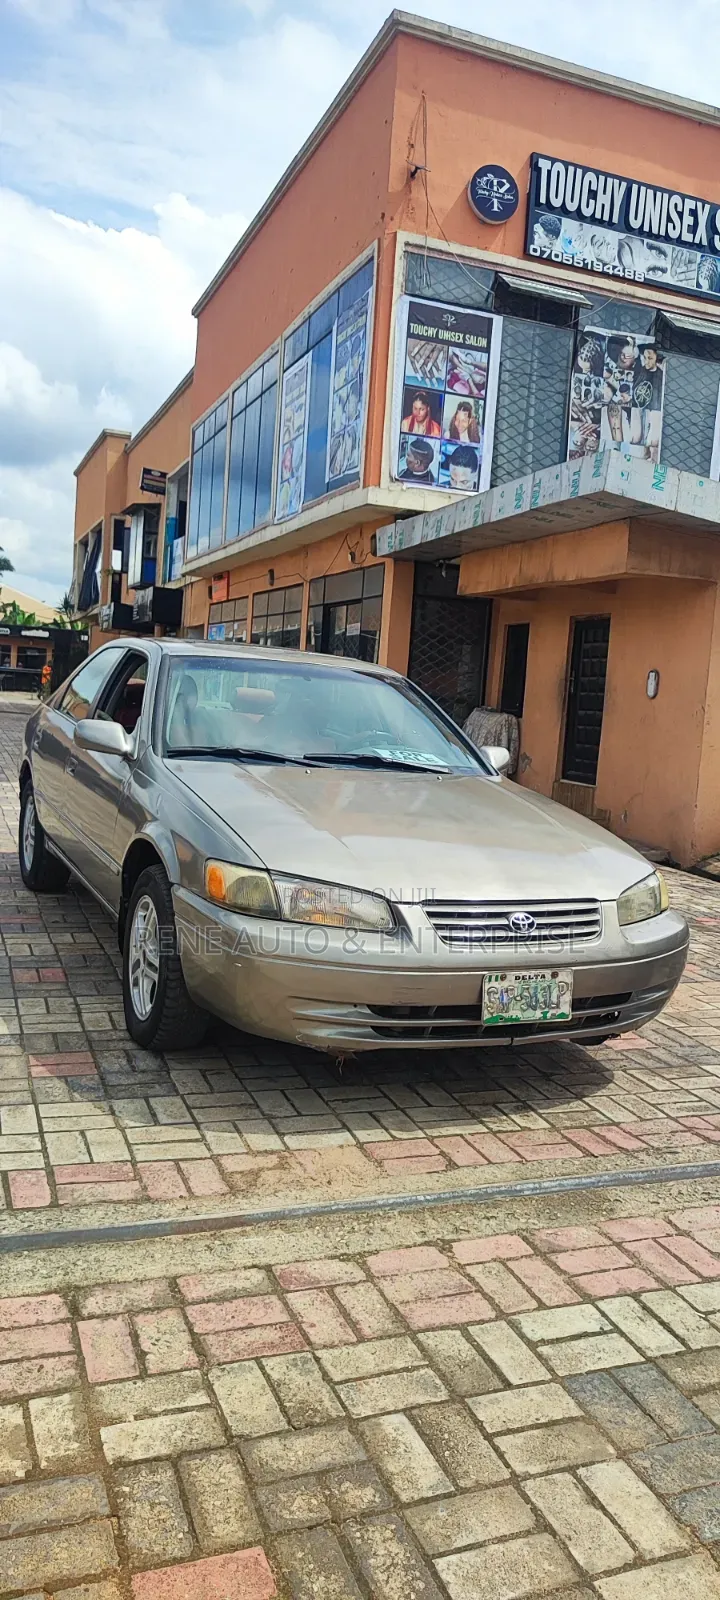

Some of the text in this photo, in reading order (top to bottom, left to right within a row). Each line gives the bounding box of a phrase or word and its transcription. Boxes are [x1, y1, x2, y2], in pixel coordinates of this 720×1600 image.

[538, 157, 627, 224] TOUCHY
[628, 182, 711, 246] UNISEX
[529, 244, 646, 282] 07055194488
[409, 322, 488, 348] TOUCHY UNISEX SALON
[514, 973, 546, 981] DELTA
